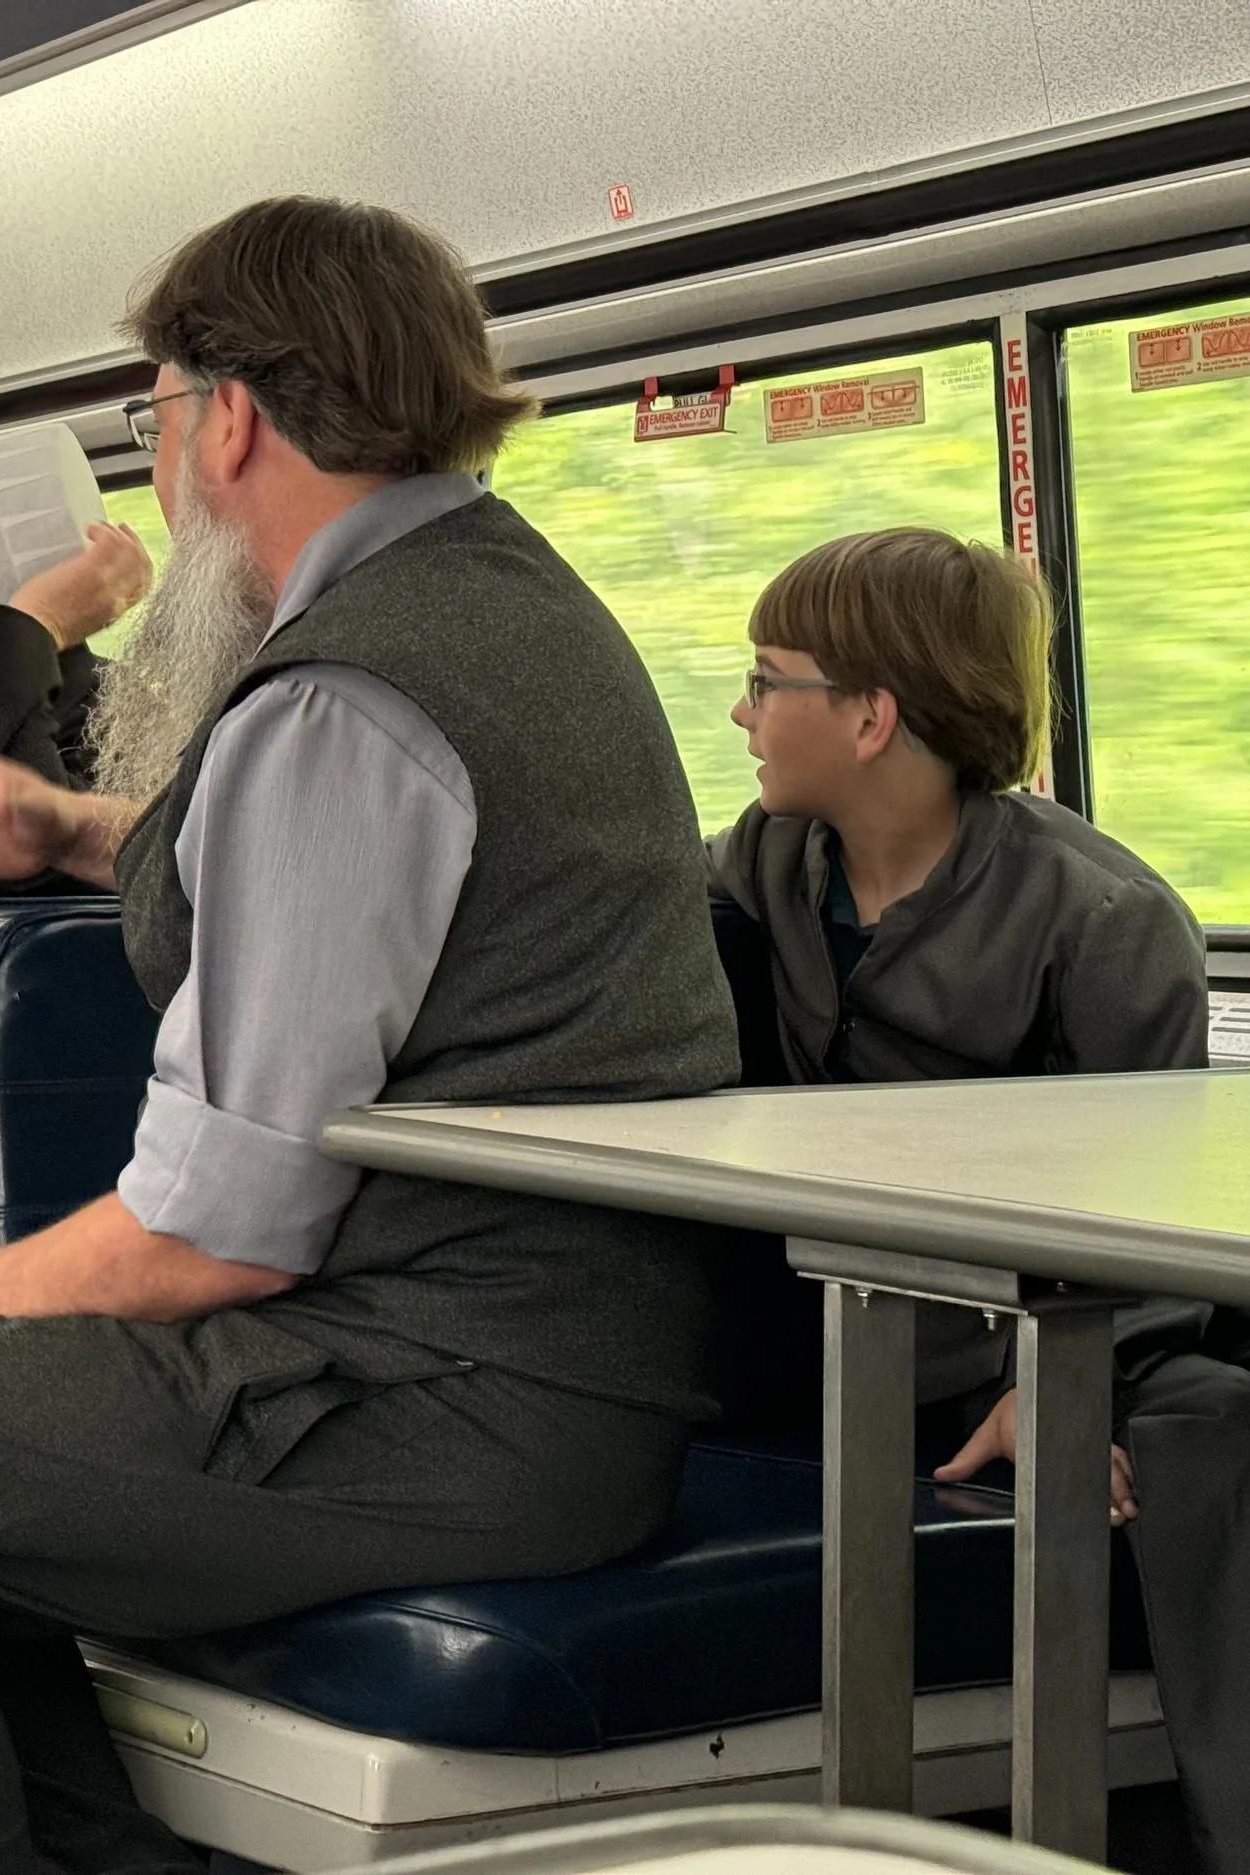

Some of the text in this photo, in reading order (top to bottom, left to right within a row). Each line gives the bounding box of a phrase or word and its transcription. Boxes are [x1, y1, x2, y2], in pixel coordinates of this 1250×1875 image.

[1137, 325, 1190, 341] EMERGENCY
[1192, 320, 1227, 332] Window
[770, 377, 869, 399] EMERGENCY Window Removal
[650, 408, 699, 425] EMERGENCY
[700, 406, 719, 419] EXIT
